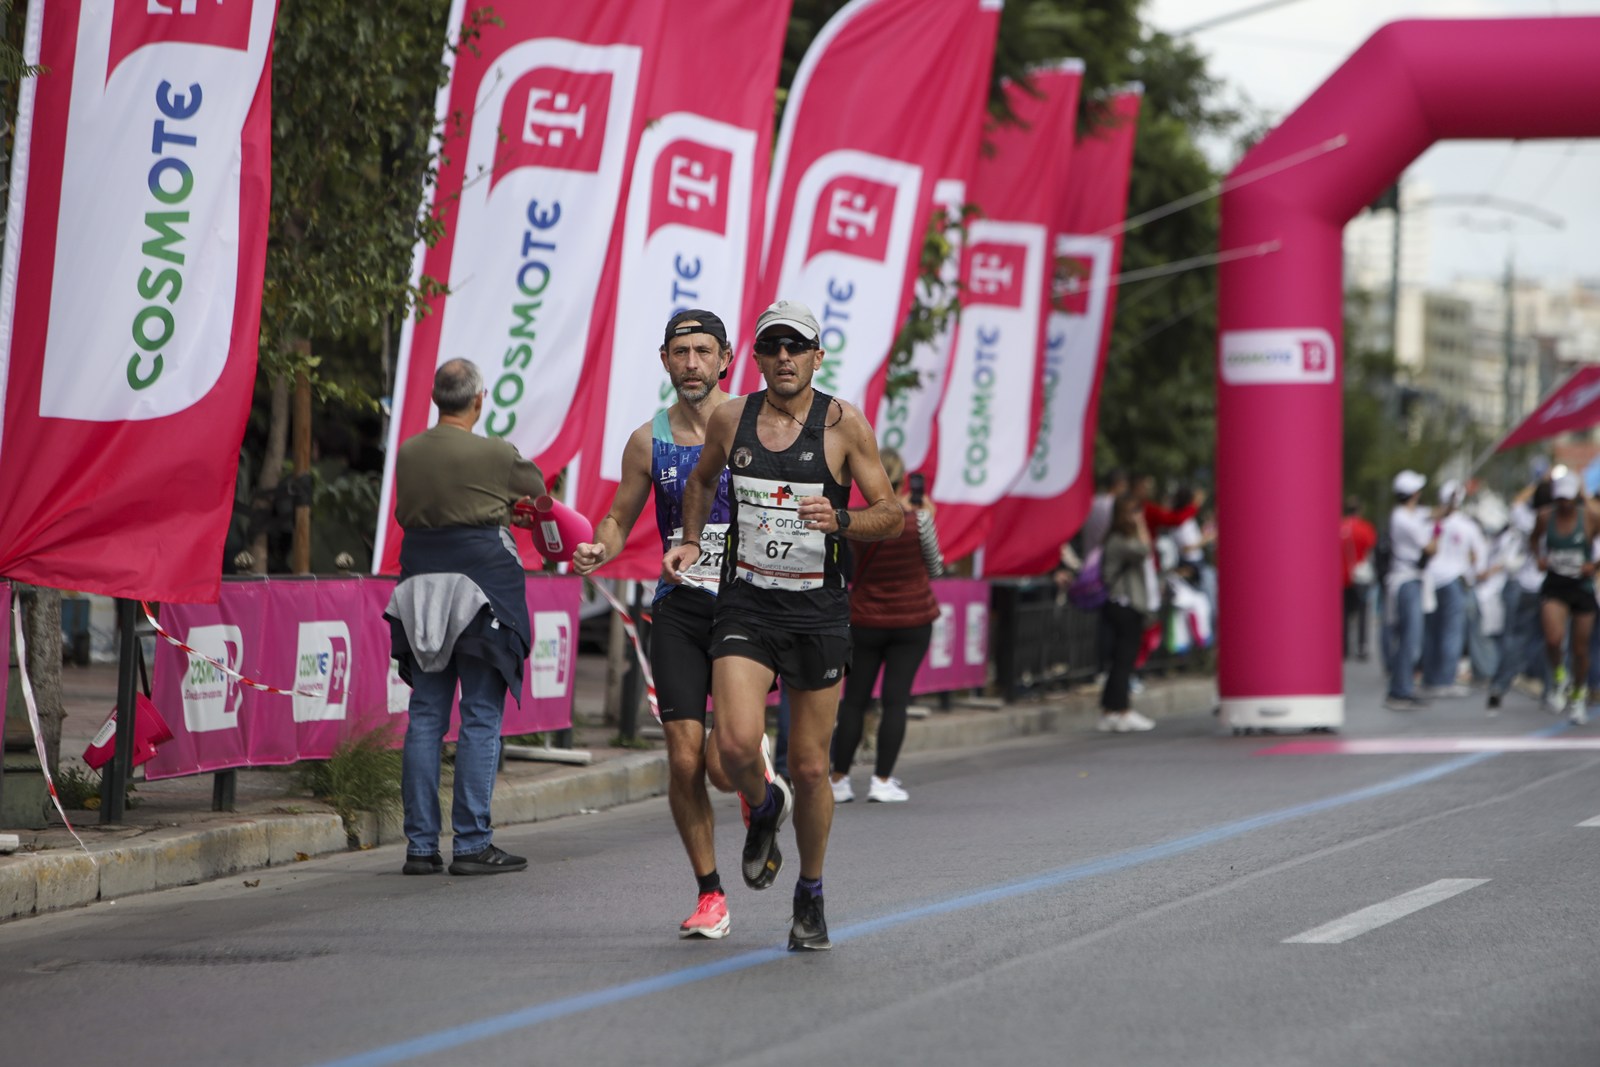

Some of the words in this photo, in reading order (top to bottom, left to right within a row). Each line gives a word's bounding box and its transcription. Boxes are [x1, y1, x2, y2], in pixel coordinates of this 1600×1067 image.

[126, 79, 203, 391] COSMOTE
[814, 277, 855, 393] MOTE
[765, 540, 793, 560] 67
